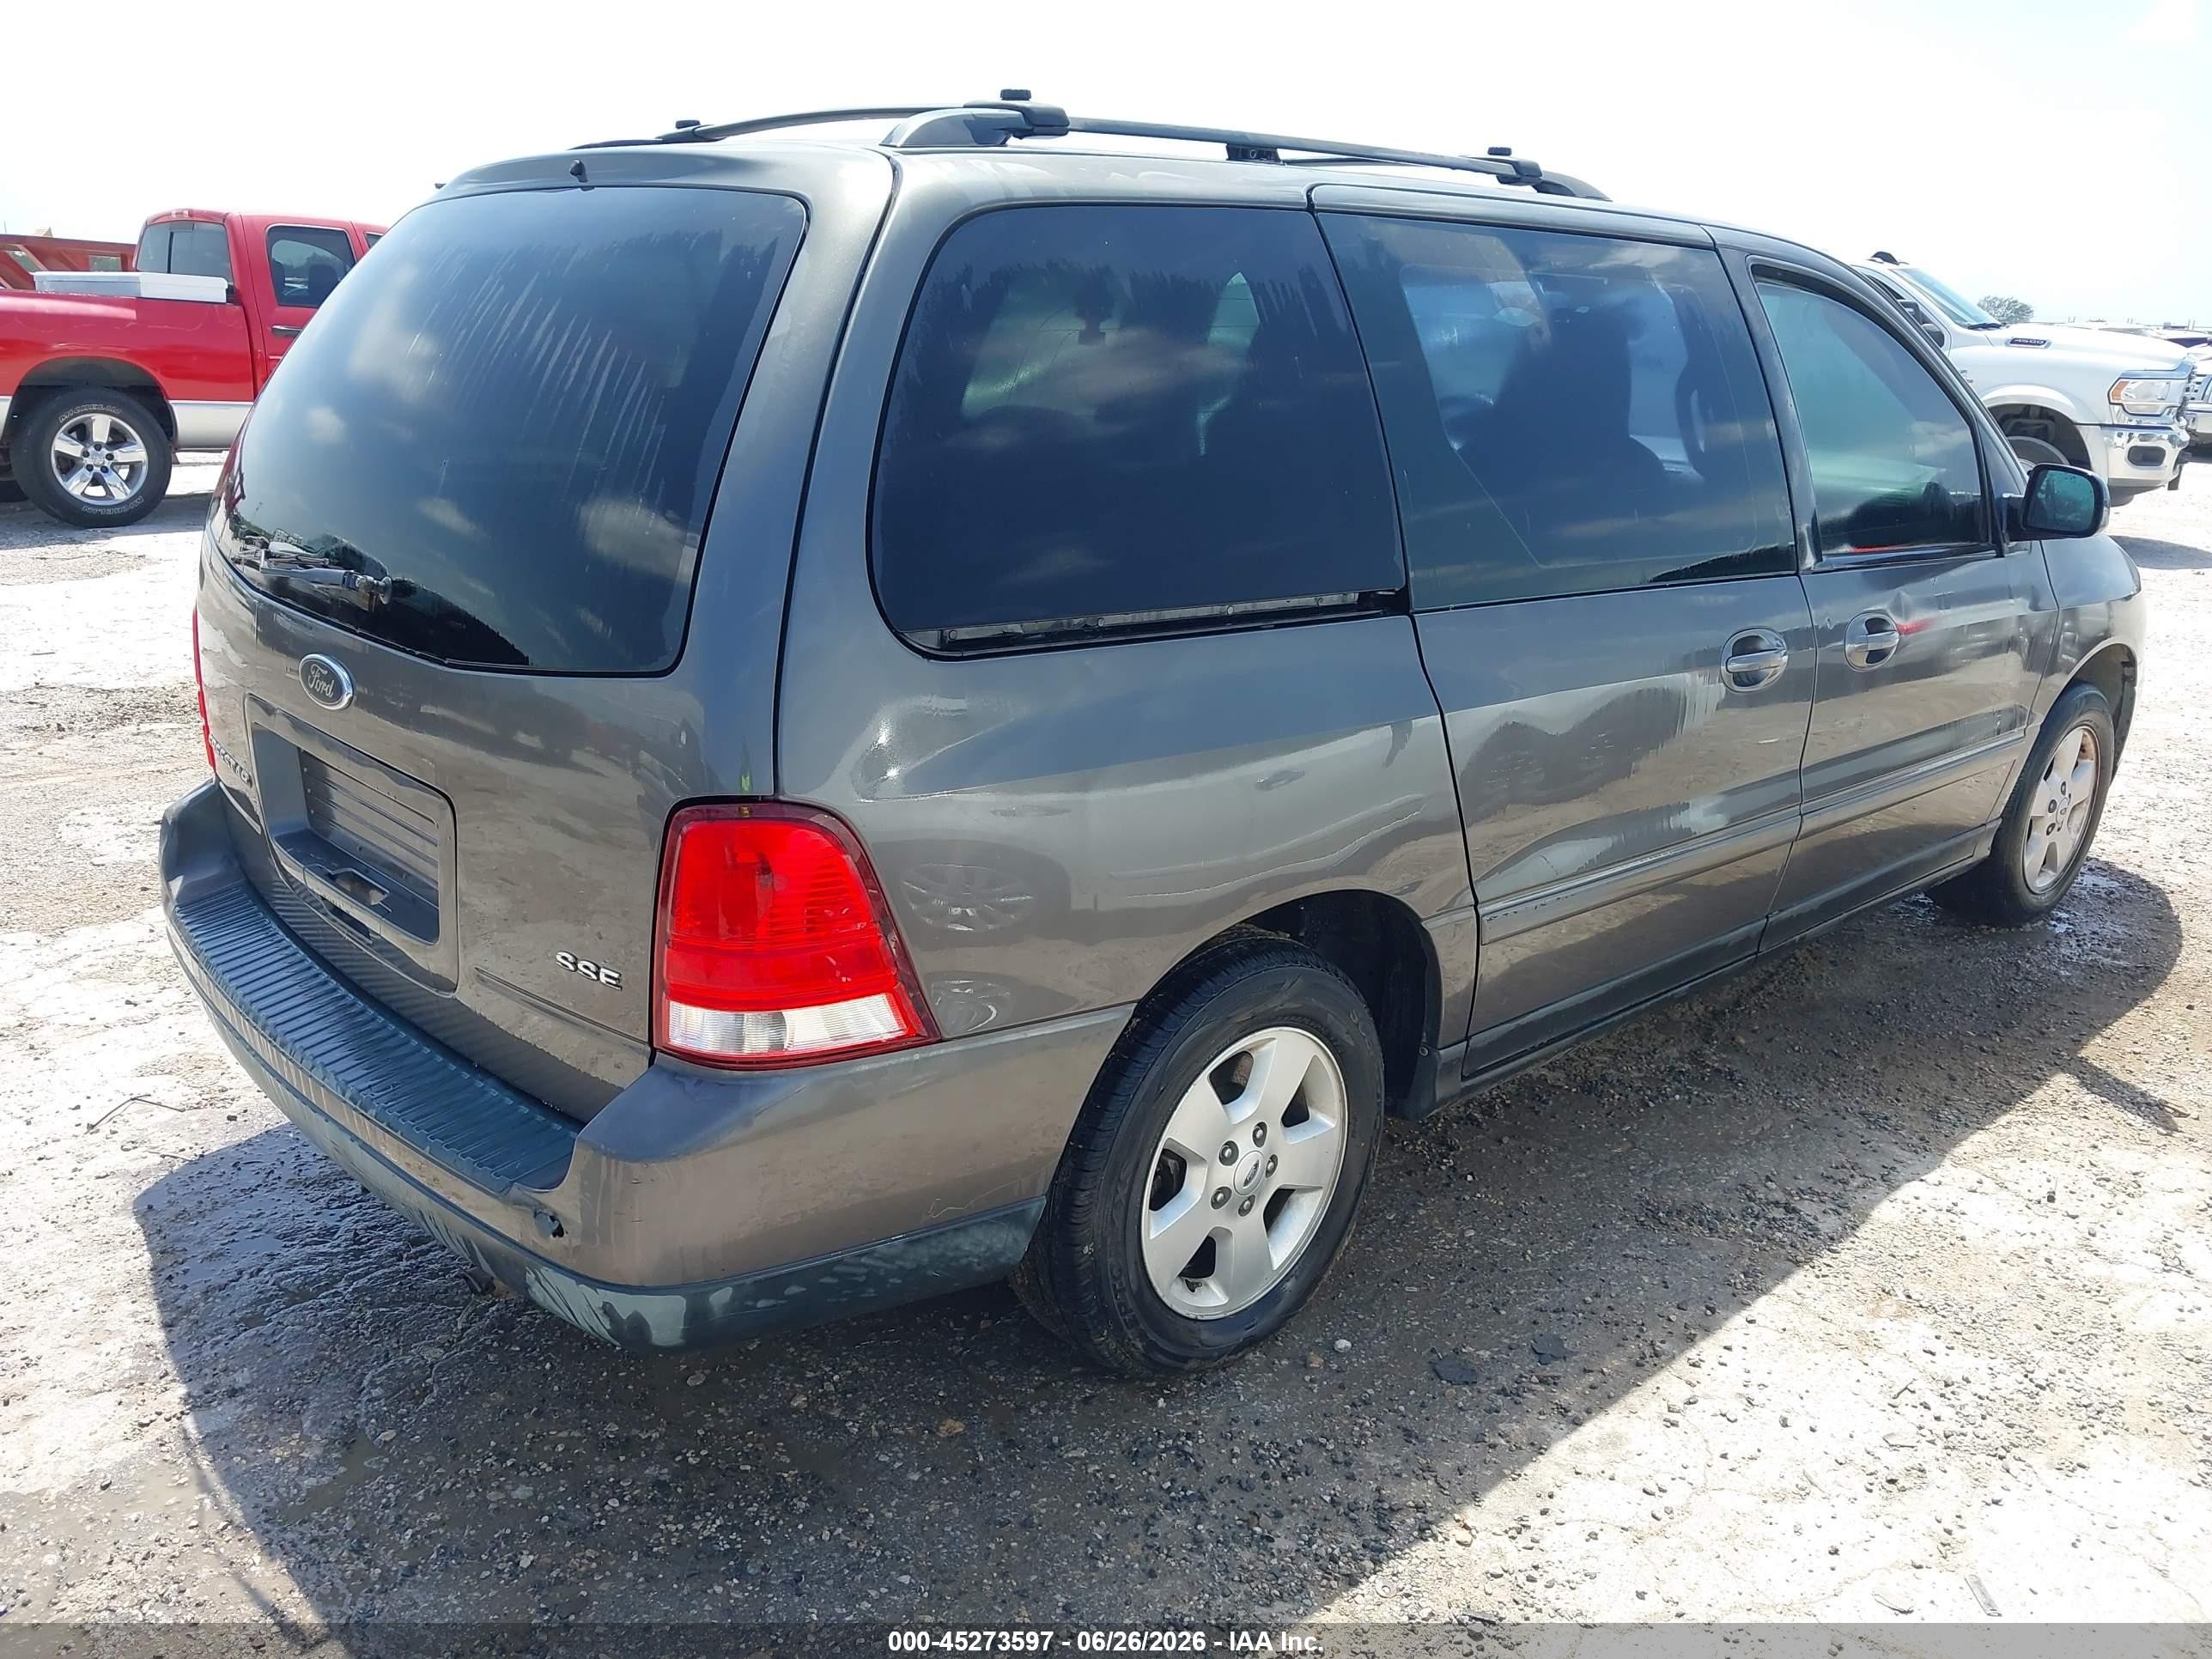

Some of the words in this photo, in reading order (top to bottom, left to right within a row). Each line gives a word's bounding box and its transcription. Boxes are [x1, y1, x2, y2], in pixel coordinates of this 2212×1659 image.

[58, 404, 123, 423] MICHELIN
[307, 663, 336, 698] Ford
[556, 950, 623, 991] SSE
